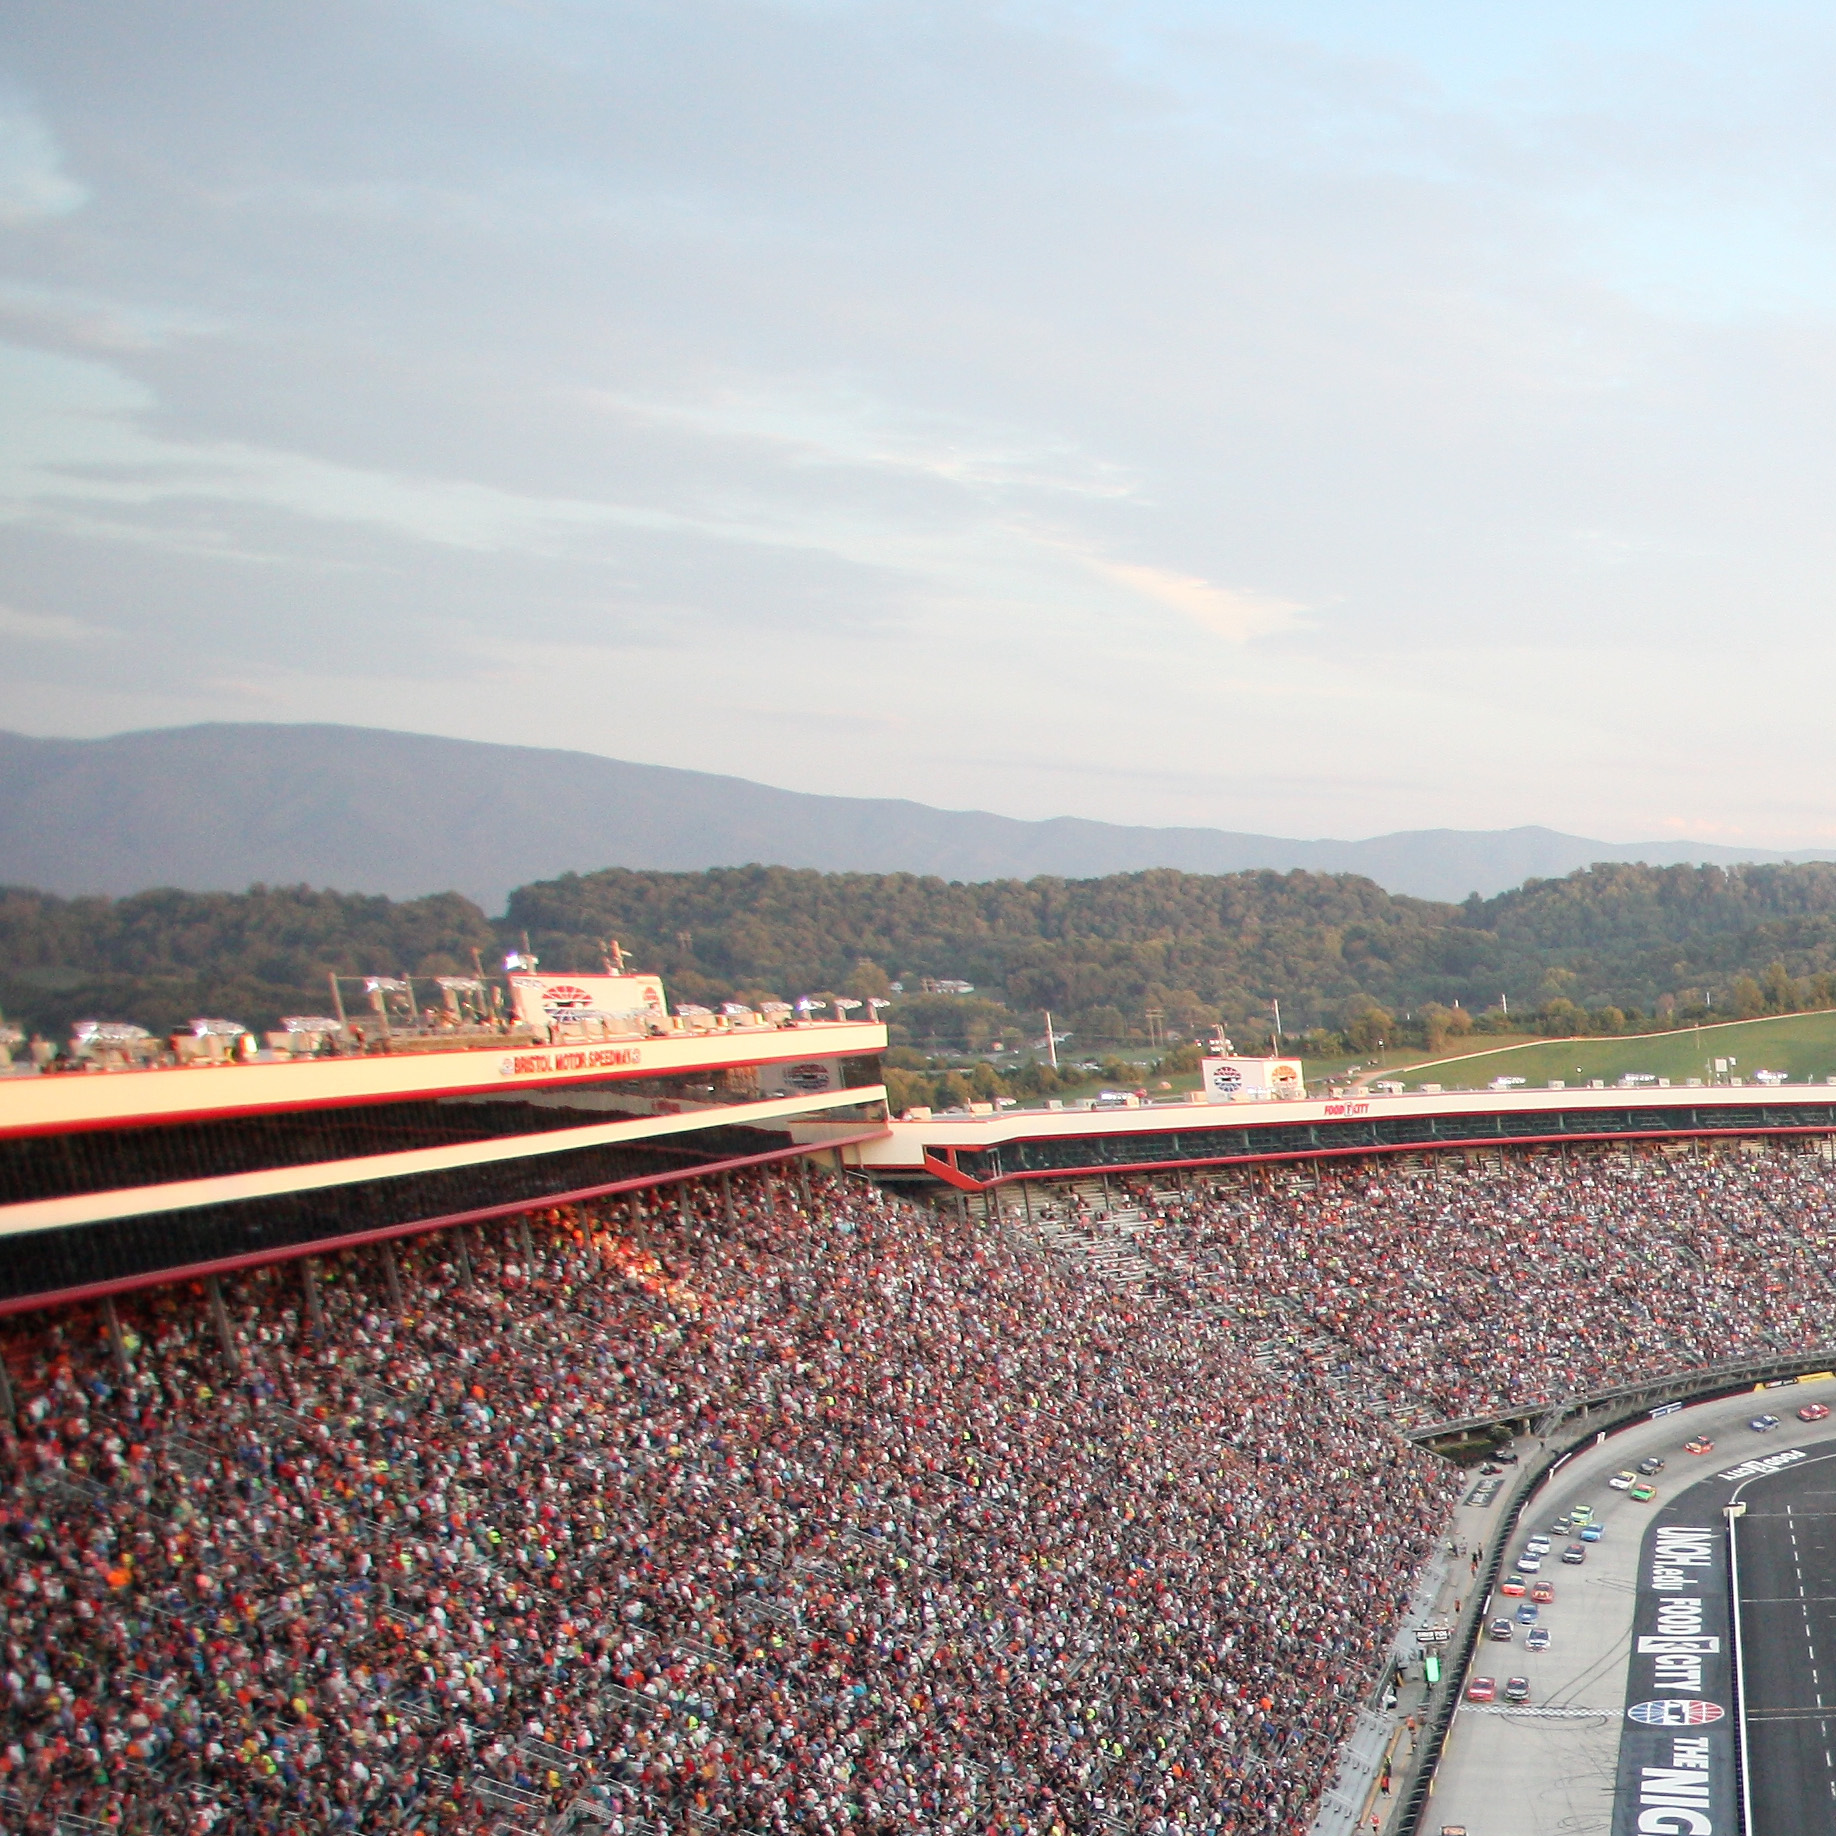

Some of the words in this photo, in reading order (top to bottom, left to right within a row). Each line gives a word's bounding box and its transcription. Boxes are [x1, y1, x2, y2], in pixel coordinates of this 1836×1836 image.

[514, 1056, 552, 1074] BRISTOL
[1651, 1527, 1712, 1591] UNOH.edu
[1657, 1598, 1702, 1635] FOOD
[1653, 1654, 1702, 1692] CITY
[1673, 1737, 1709, 1768] THE
